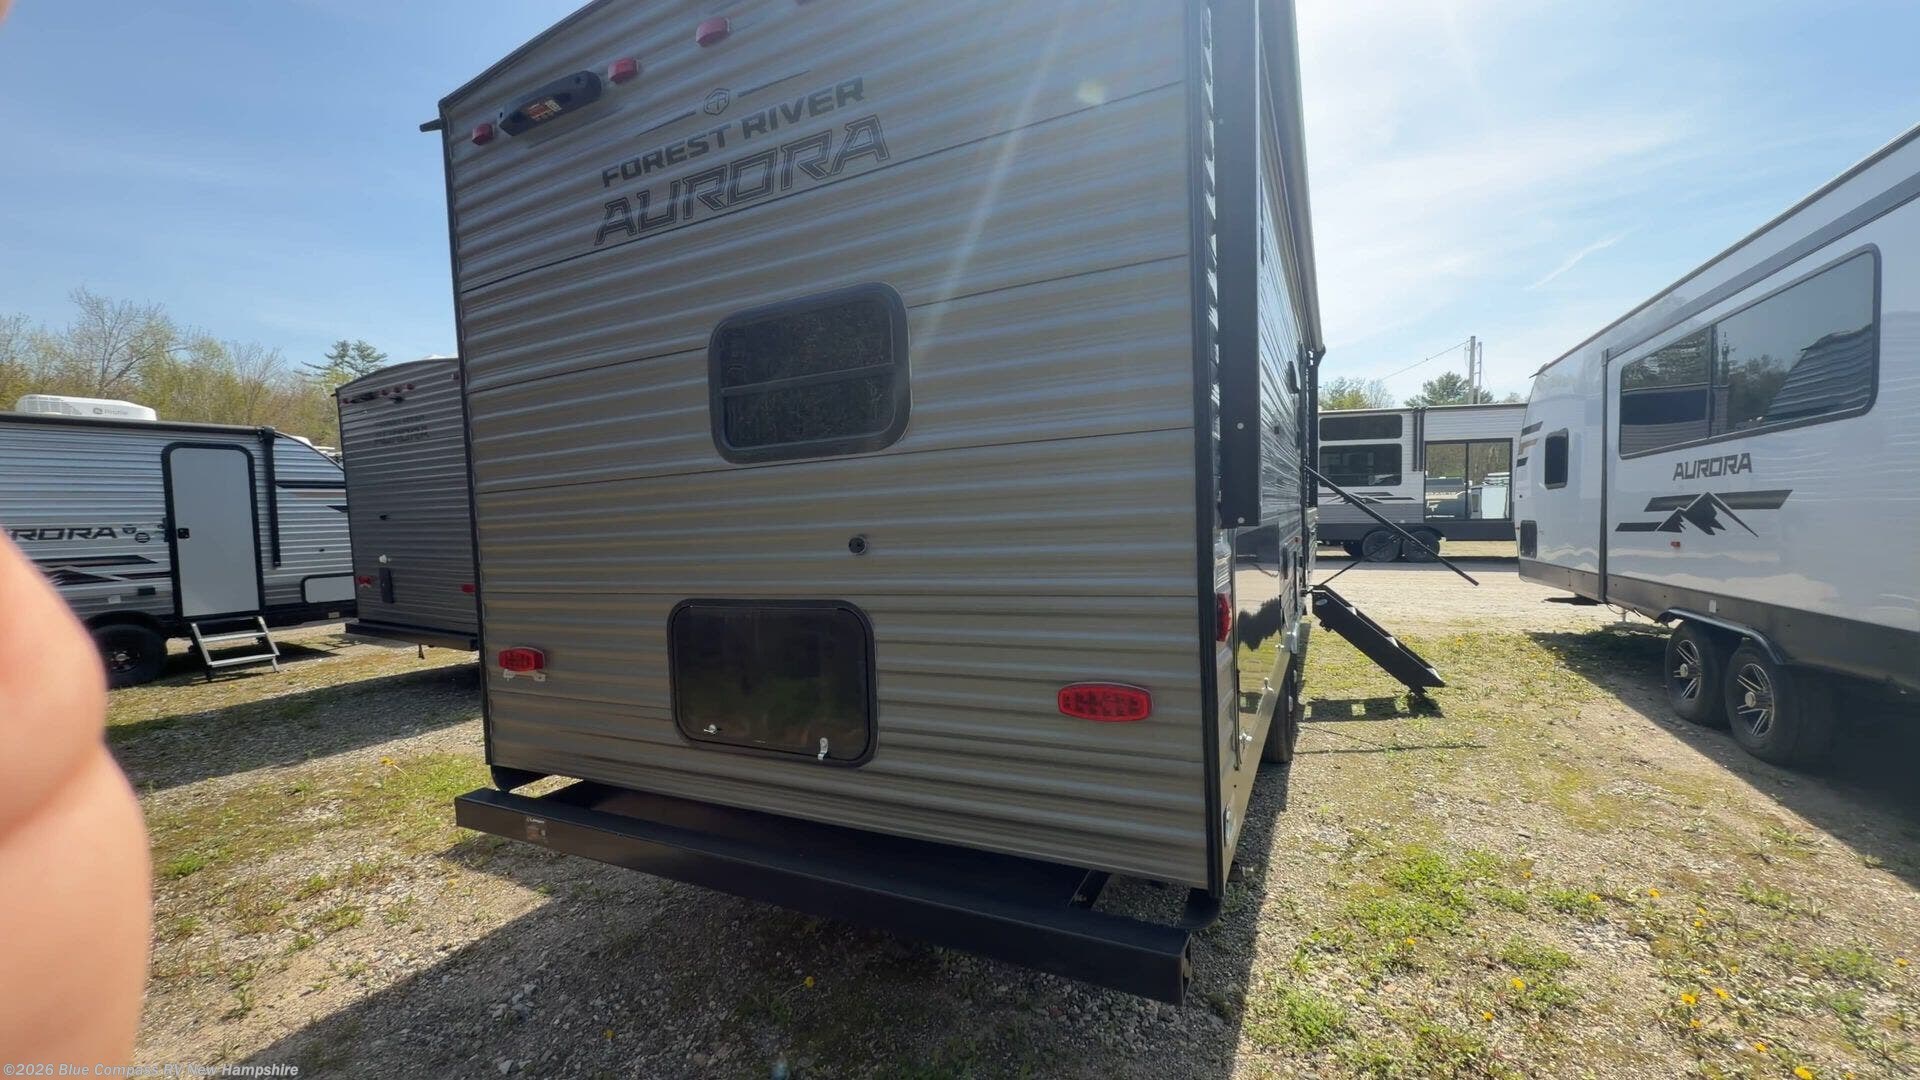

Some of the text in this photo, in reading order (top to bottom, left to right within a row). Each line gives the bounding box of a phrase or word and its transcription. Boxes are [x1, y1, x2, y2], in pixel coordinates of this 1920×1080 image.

[602, 77, 865, 188] FOREST RIVER
[594, 114, 891, 246] AURORA
[1672, 452, 1753, 481] AURORA
[10, 526, 118, 541] RORA
